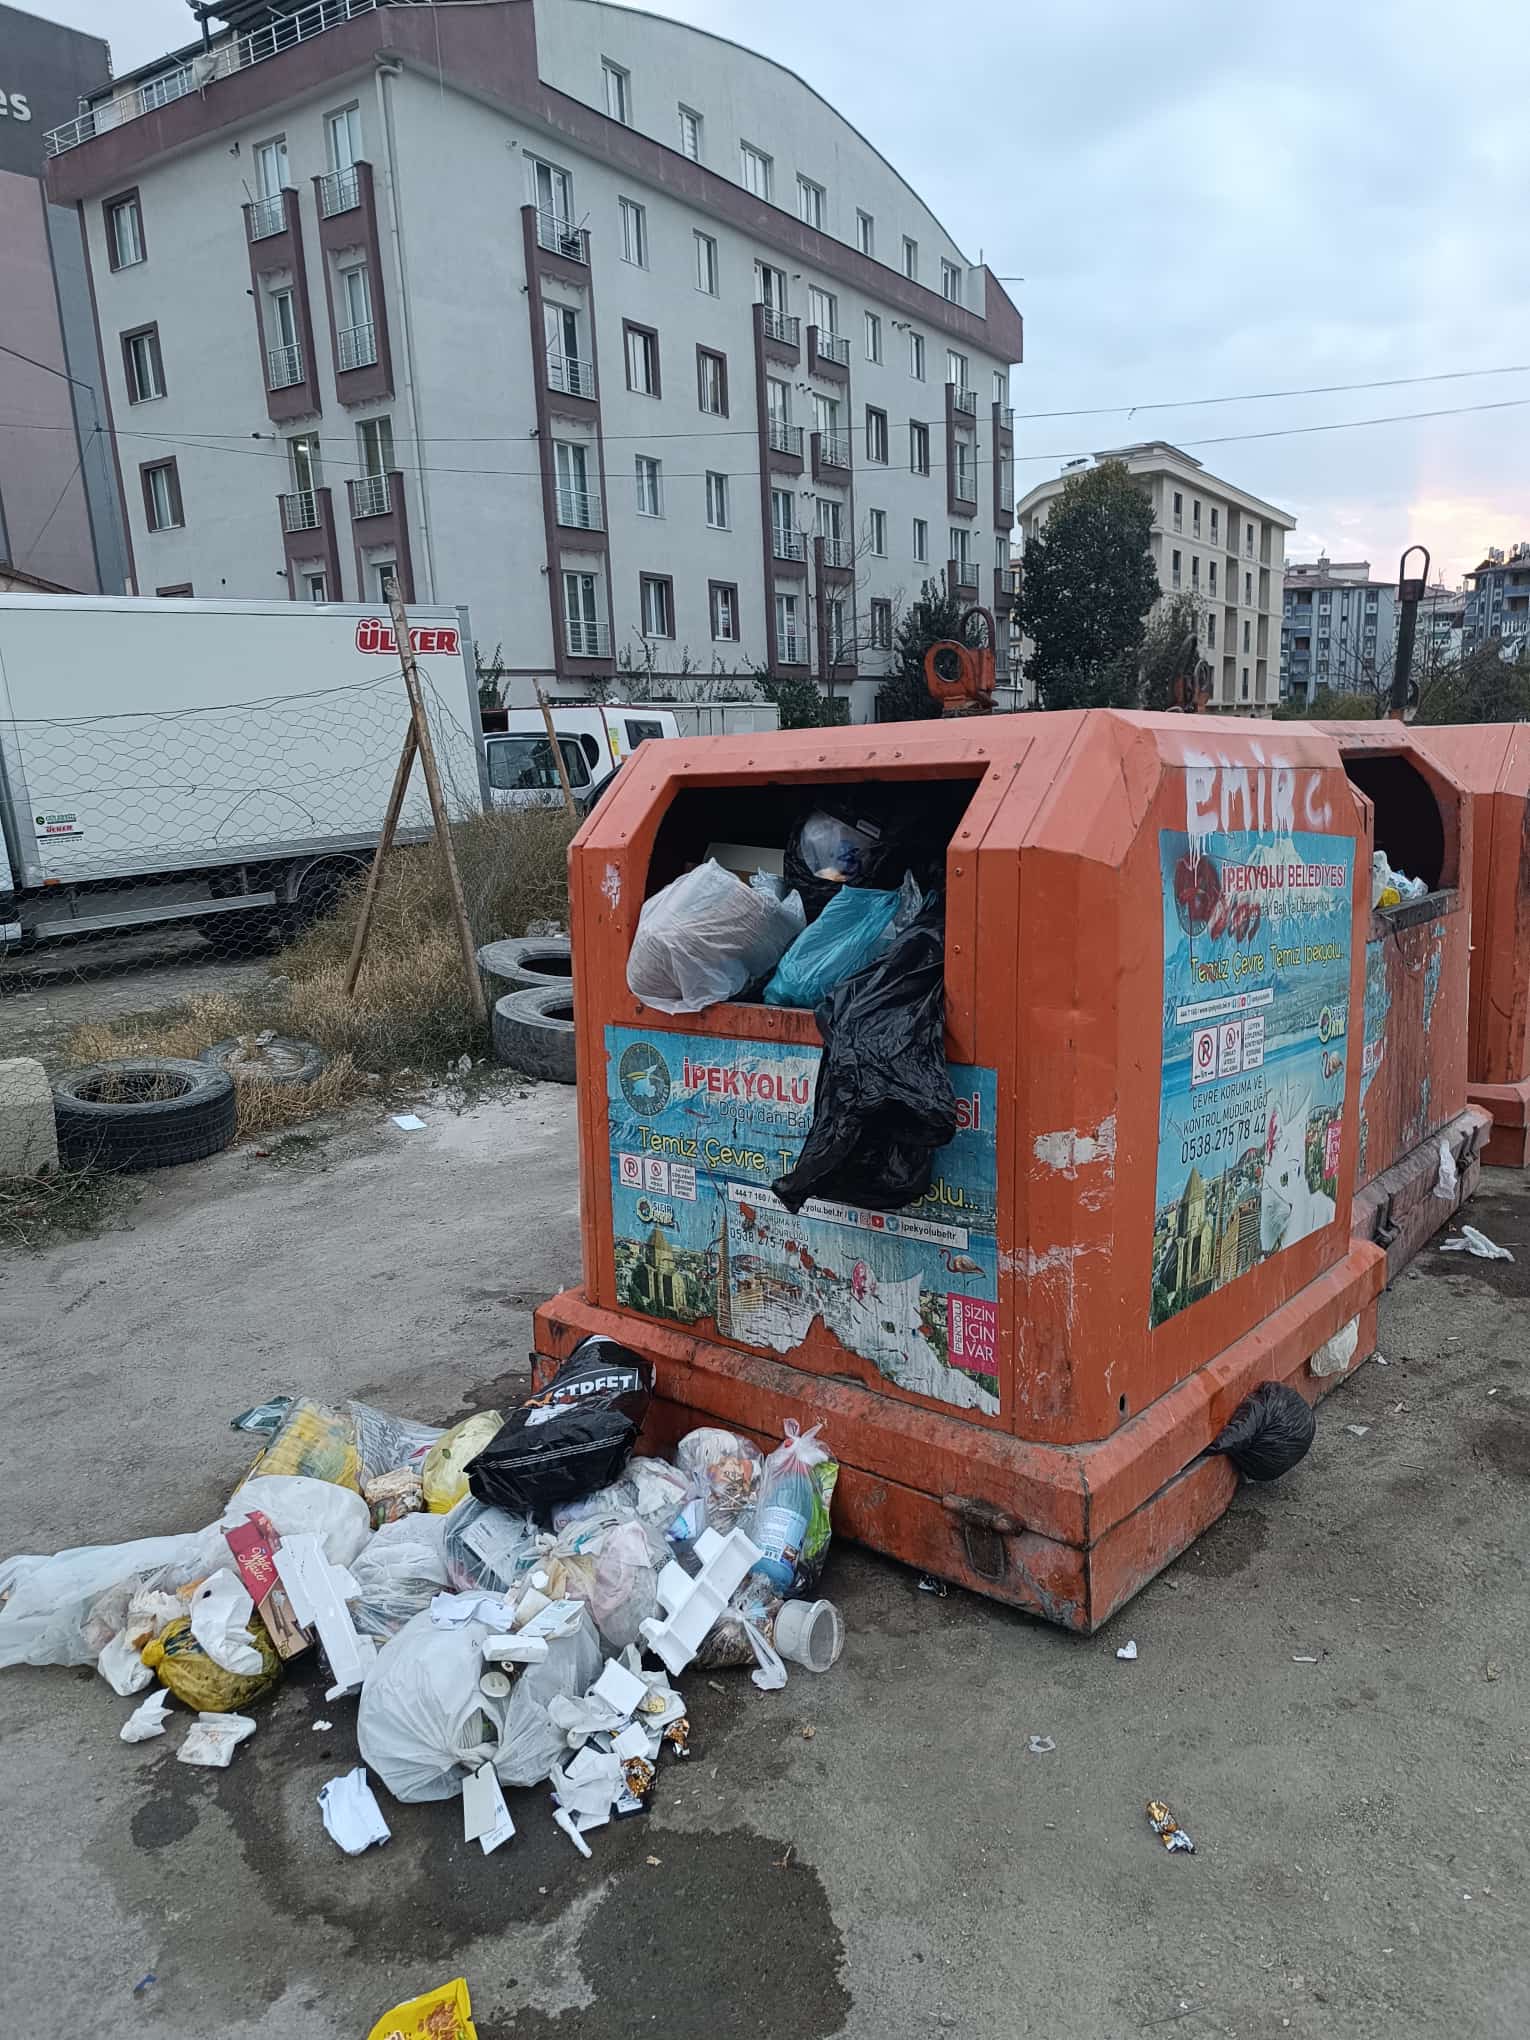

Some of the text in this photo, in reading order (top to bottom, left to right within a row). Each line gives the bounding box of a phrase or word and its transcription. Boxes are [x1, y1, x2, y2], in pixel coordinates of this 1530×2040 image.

[1222, 857, 1348, 893] İPEKYOLU BELEDİYESİ
[682, 1056, 810, 1105] İPEKYOLU
[1193, 1074, 1263, 1113] ÇEVRE KORUMA VE
[1181, 1132, 1211, 1165] 0538
[1214, 1124, 1234, 1152] 275
[1254, 1112, 1266, 1134] 42
[1183, 1111, 1222, 1136] KONTROL
[639, 1126, 698, 1159] Temiz
[704, 1137, 771, 1174] Çevre,
[954, 1301, 963, 1353] İPEKYOLU
[964, 1303, 995, 1324] SİZİN
[964, 1318, 995, 1343] İÇİN
[965, 1340, 995, 1363] VAR
